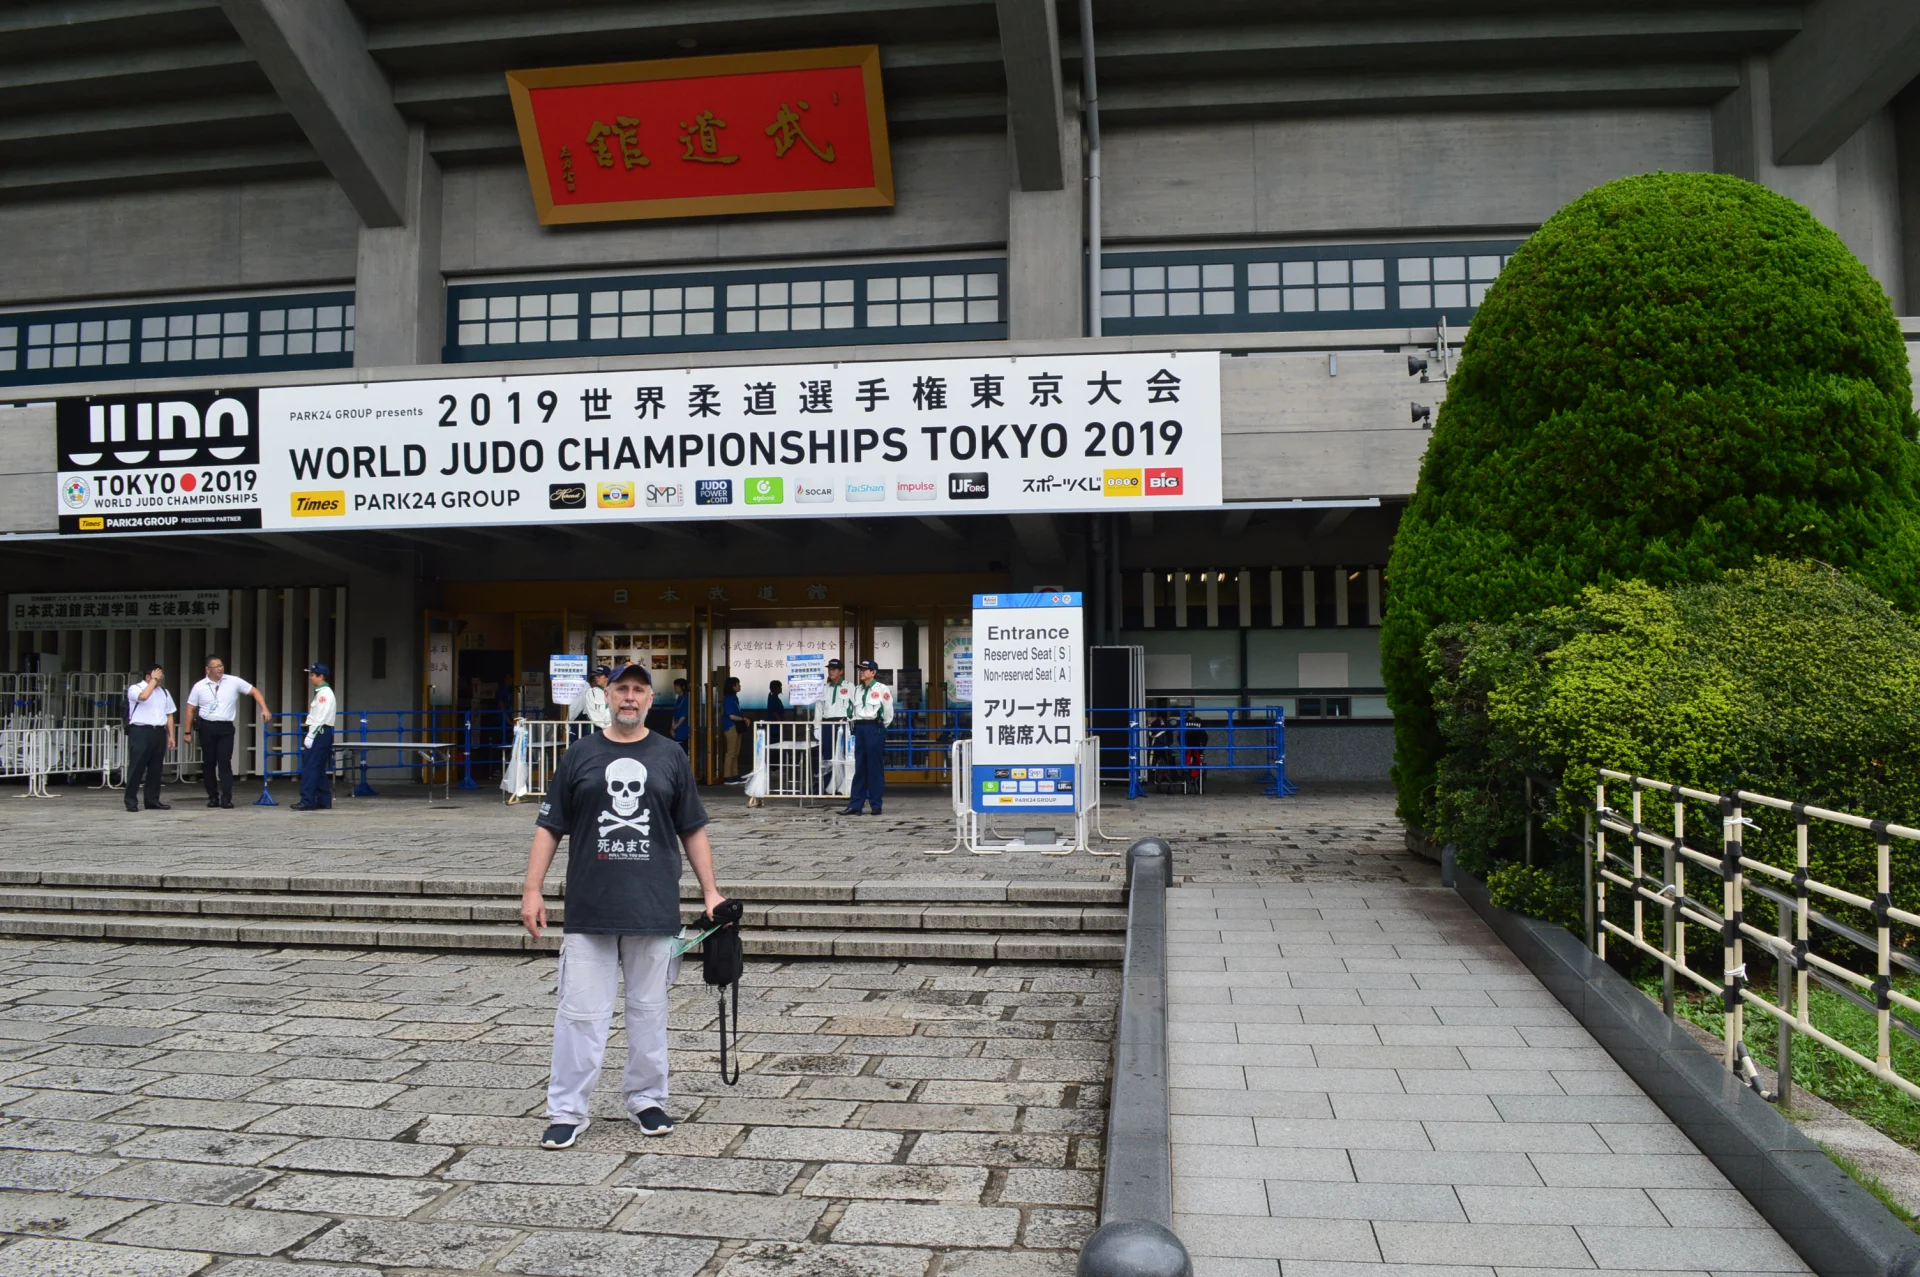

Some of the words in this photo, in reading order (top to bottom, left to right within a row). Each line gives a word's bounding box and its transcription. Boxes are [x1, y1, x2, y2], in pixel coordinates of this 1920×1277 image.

[289, 407, 331, 422] PARK24
[335, 408, 373, 421] GROUP
[375, 407, 424, 420] presents
[289, 443, 427, 481] WORLD
[440, 439, 544, 476] JUDO
[558, 426, 908, 471] CHAMPIONSHIPS
[921, 423, 1068, 460] TOKYO
[1084, 419, 1183, 458] 2019
[94, 472, 175, 496] TOKYO
[201, 469, 258, 492] 2019
[700, 481, 728, 490] JUDO
[846, 484, 885, 493] TaiShan
[897, 481, 935, 492] impulse
[1022, 474, 1102, 493] スポーツくじ
[1107, 478, 1139, 487] toto
[646, 484, 677, 503] SMP
[700, 489, 728, 497] POWER
[805, 488, 832, 496] SOCAR
[94, 496, 132, 508] WORLD
[136, 496, 164, 507] JUDO
[167, 493, 258, 506] CHAMPIONSHIPS
[296, 497, 339, 511] Times
[354, 491, 436, 511] PARK24
[441, 489, 520, 508] GROUP
[82, 520, 101, 528] Times
[106, 518, 143, 528] PARK24
[144, 516, 179, 526] GROUP
[181, 516, 215, 524] PRESENTING
[613, 584, 829, 603] 日本武道館
[15, 602, 139, 618] 日本武道館武道学園
[148, 600, 220, 616] 生徒募集中
[987, 626, 1070, 640] Entrance
[984, 647, 1028, 661] Reserved
[1031, 647, 1053, 661] Seat
[983, 667, 1034, 682] Non-reserved
[1035, 667, 1052, 681] Seat
[984, 696, 1071, 719] アリーナ席
[985, 724, 1071, 746] 1階席入口
[597, 839, 650, 853] 死ぬまで
